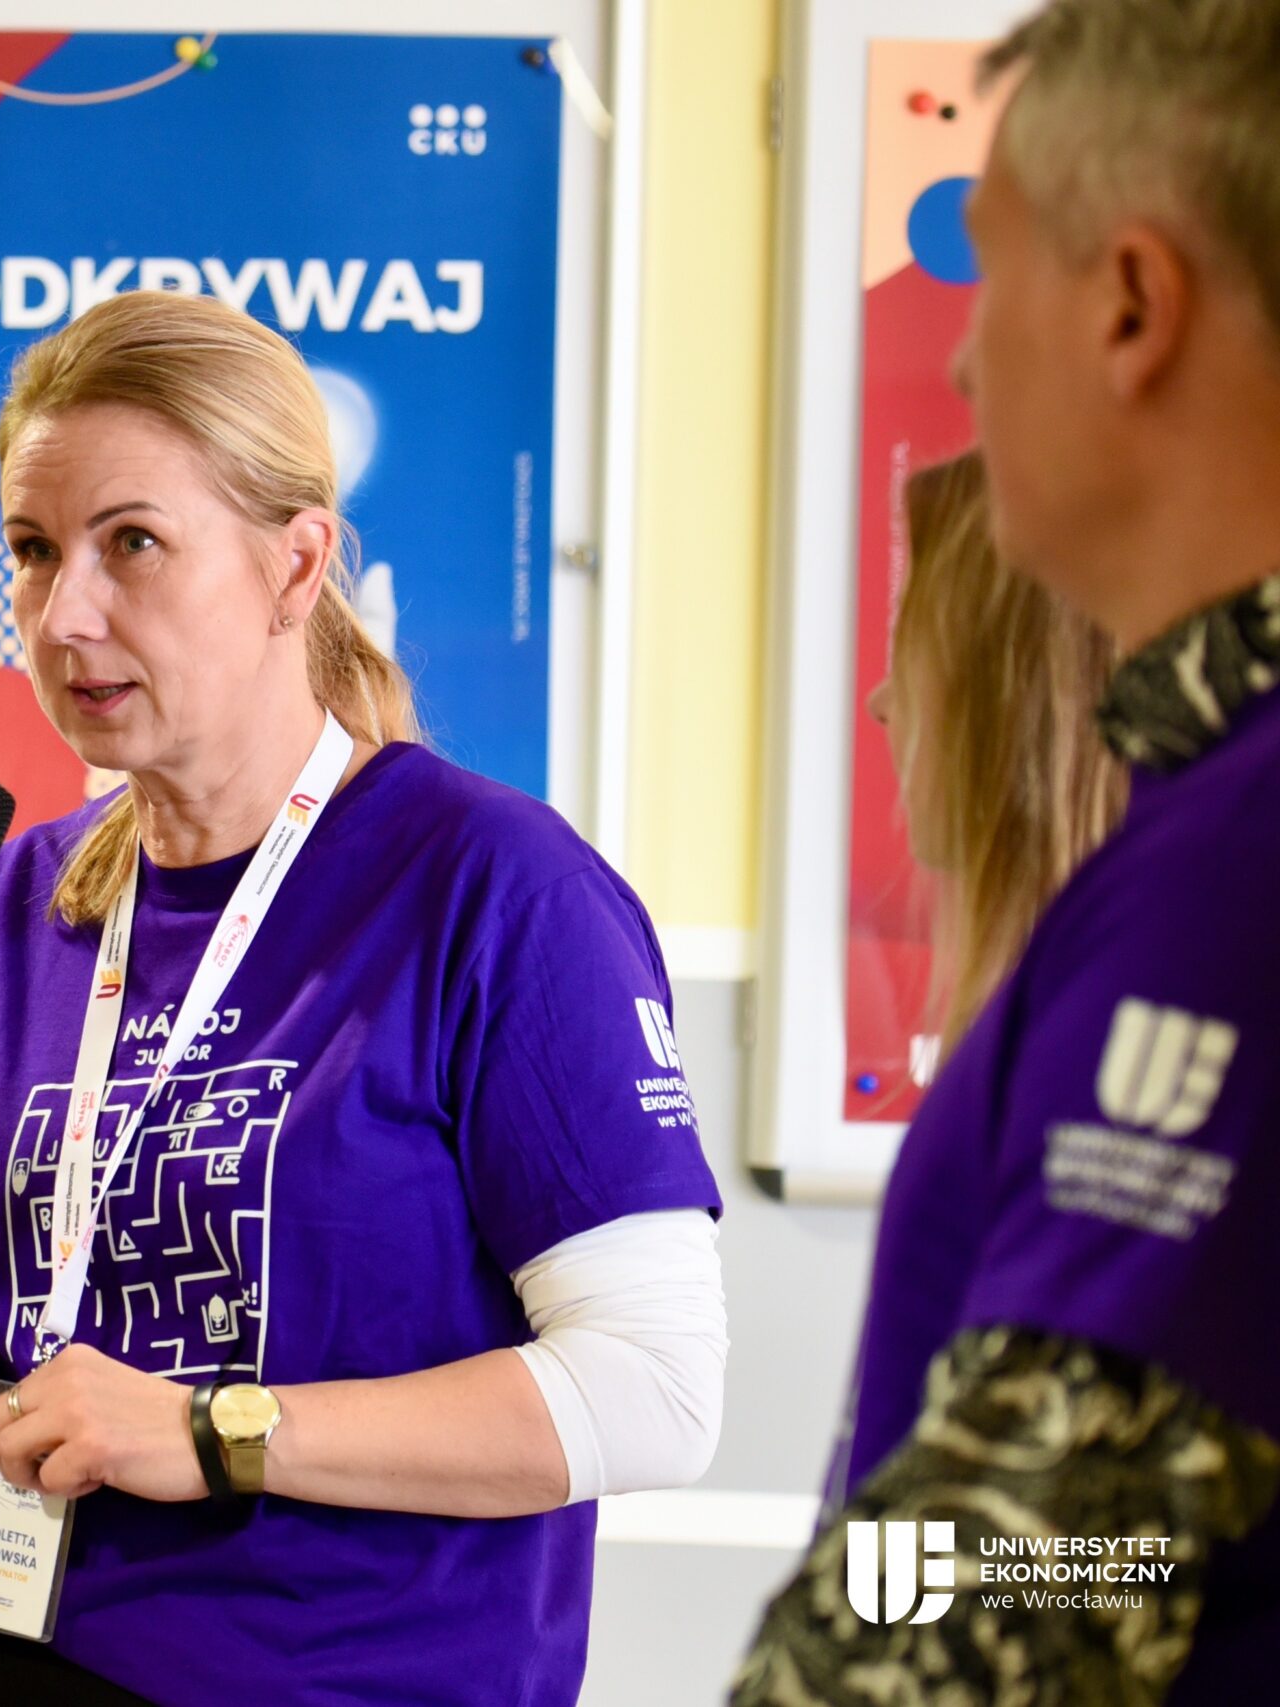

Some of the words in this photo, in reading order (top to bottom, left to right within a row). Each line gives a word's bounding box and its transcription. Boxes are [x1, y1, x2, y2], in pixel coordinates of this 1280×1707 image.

[407, 128, 487, 156] CKU
[122, 1004, 242, 1042] NÁOJ
[134, 1044, 212, 1066] JUOR
